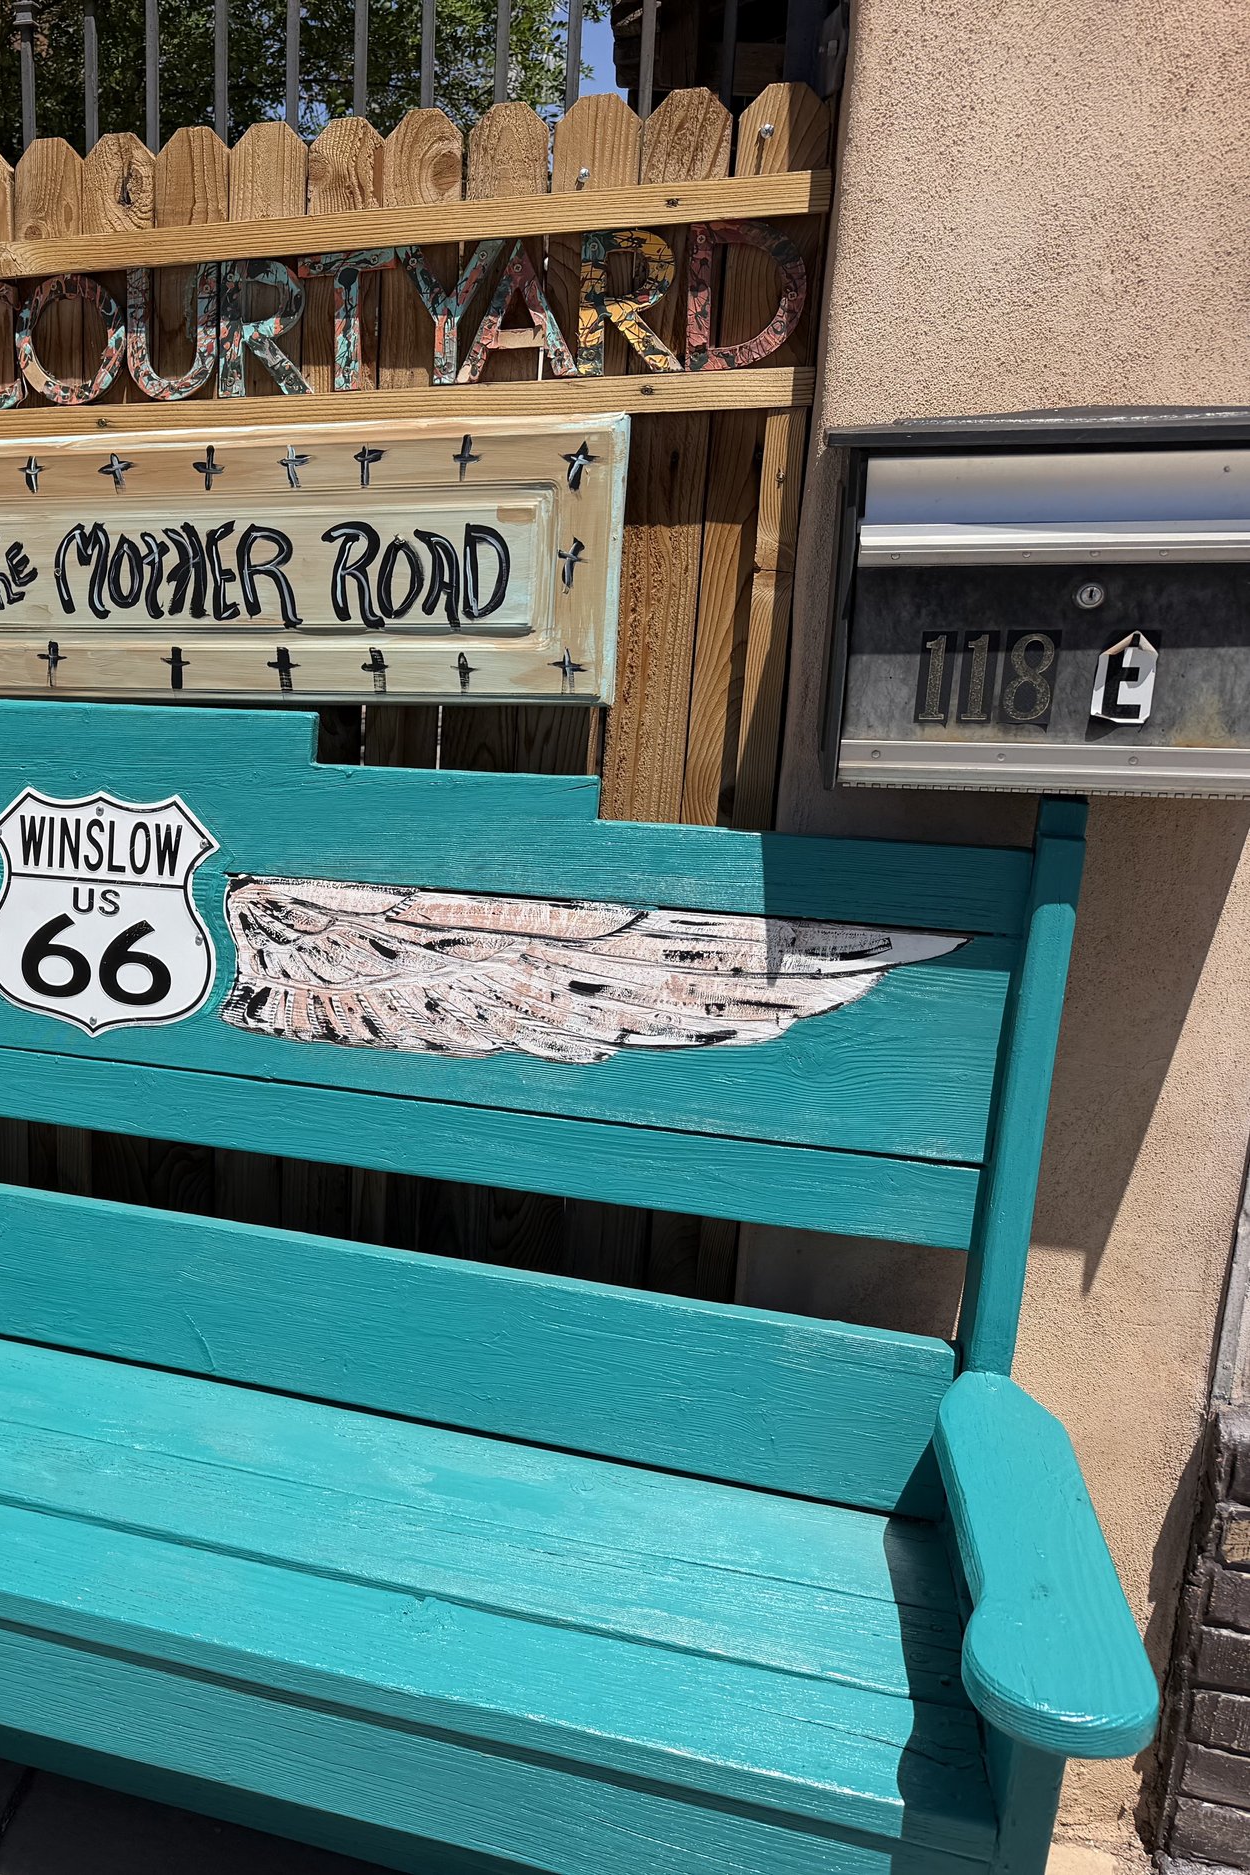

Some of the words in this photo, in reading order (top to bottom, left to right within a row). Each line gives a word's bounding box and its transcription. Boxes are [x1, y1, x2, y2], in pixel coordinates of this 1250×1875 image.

[322, 520, 510, 631] ROAD
[918, 632, 1055, 721] 118
[1100, 632, 1143, 720] E
[20, 814, 183, 877] WINSLOW
[72, 886, 121, 916] US
[21, 913, 172, 1006] 66
